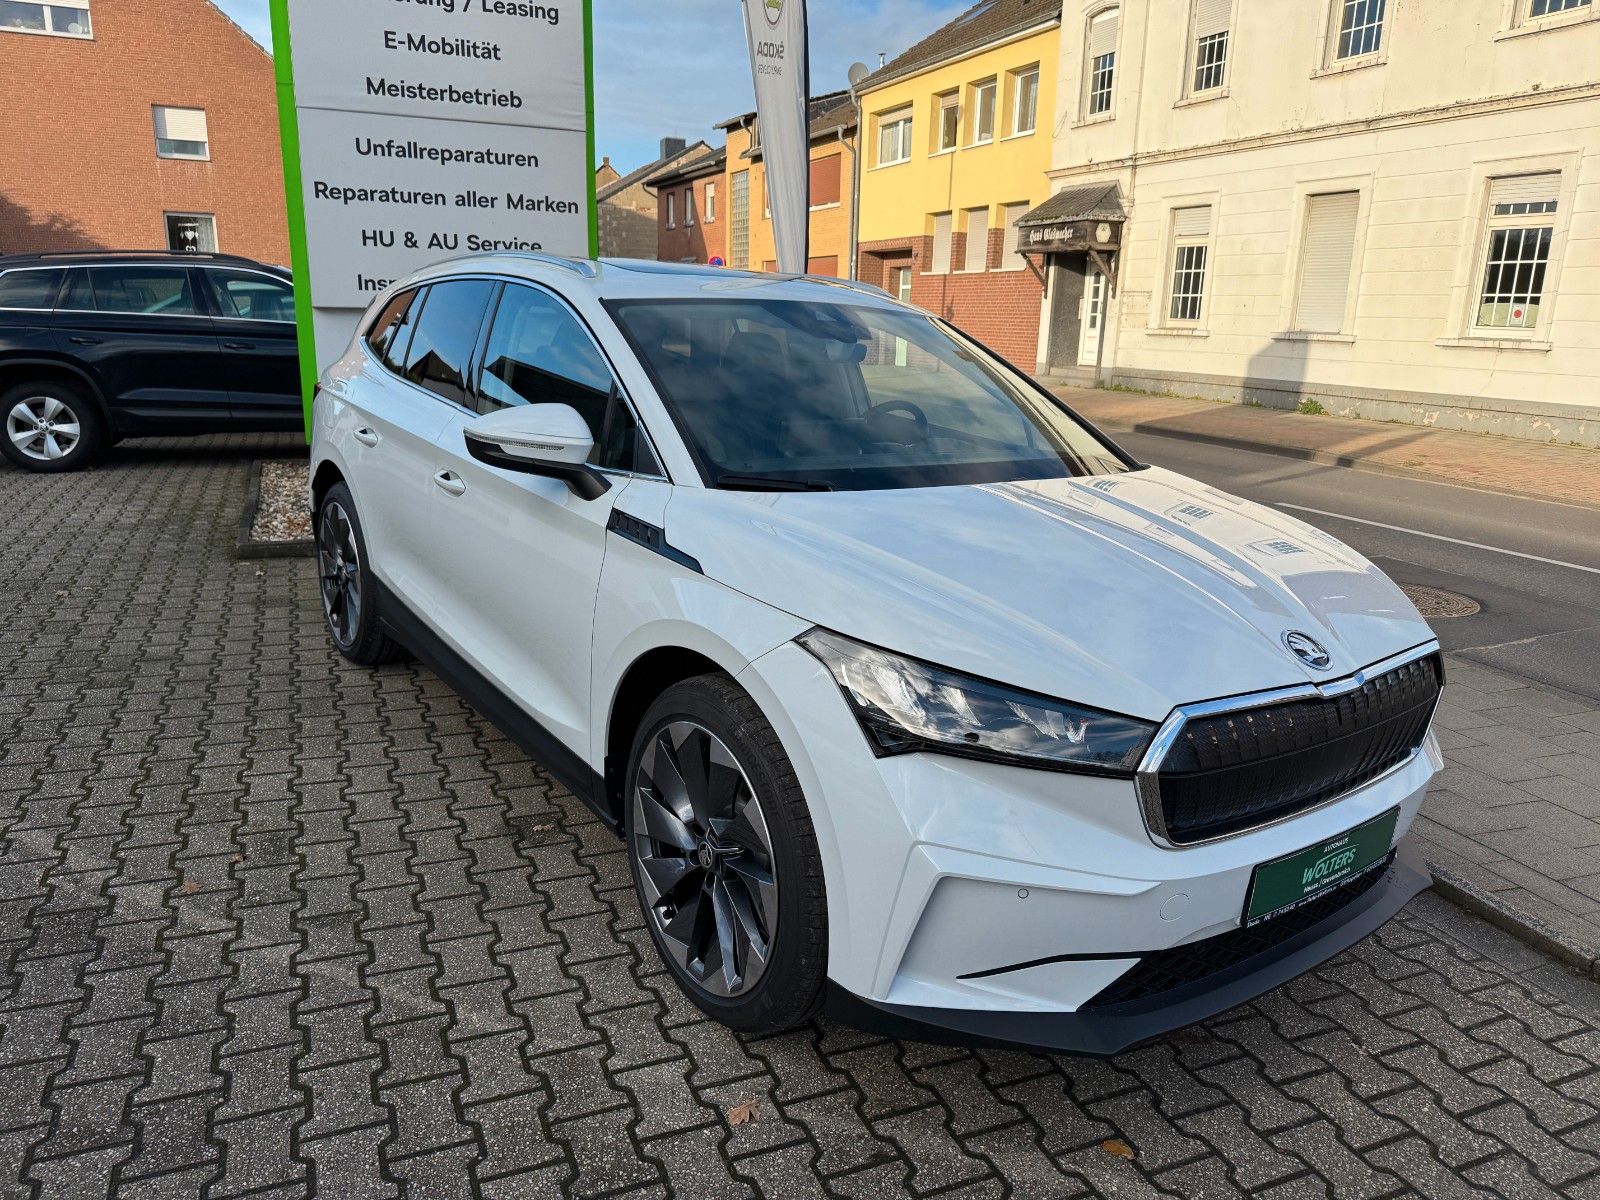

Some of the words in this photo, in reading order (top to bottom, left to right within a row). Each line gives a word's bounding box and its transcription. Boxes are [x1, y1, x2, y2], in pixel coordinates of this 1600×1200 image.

[481, 0, 559, 25] Leasing
[384, 30, 501, 60] E-Mobilität
[366, 77, 522, 108] Meisterbetrieb
[355, 137, 539, 167] Unfallreparaturen
[314, 181, 446, 206] Reparaturen
[455, 190, 498, 209] aller
[506, 193, 579, 214] Marken
[361, 229, 395, 248] HU
[403, 231, 419, 249] &
[427, 233, 459, 250] AU
[466, 235, 542, 251] Service
[1302, 847, 1356, 884] WOLTERS
